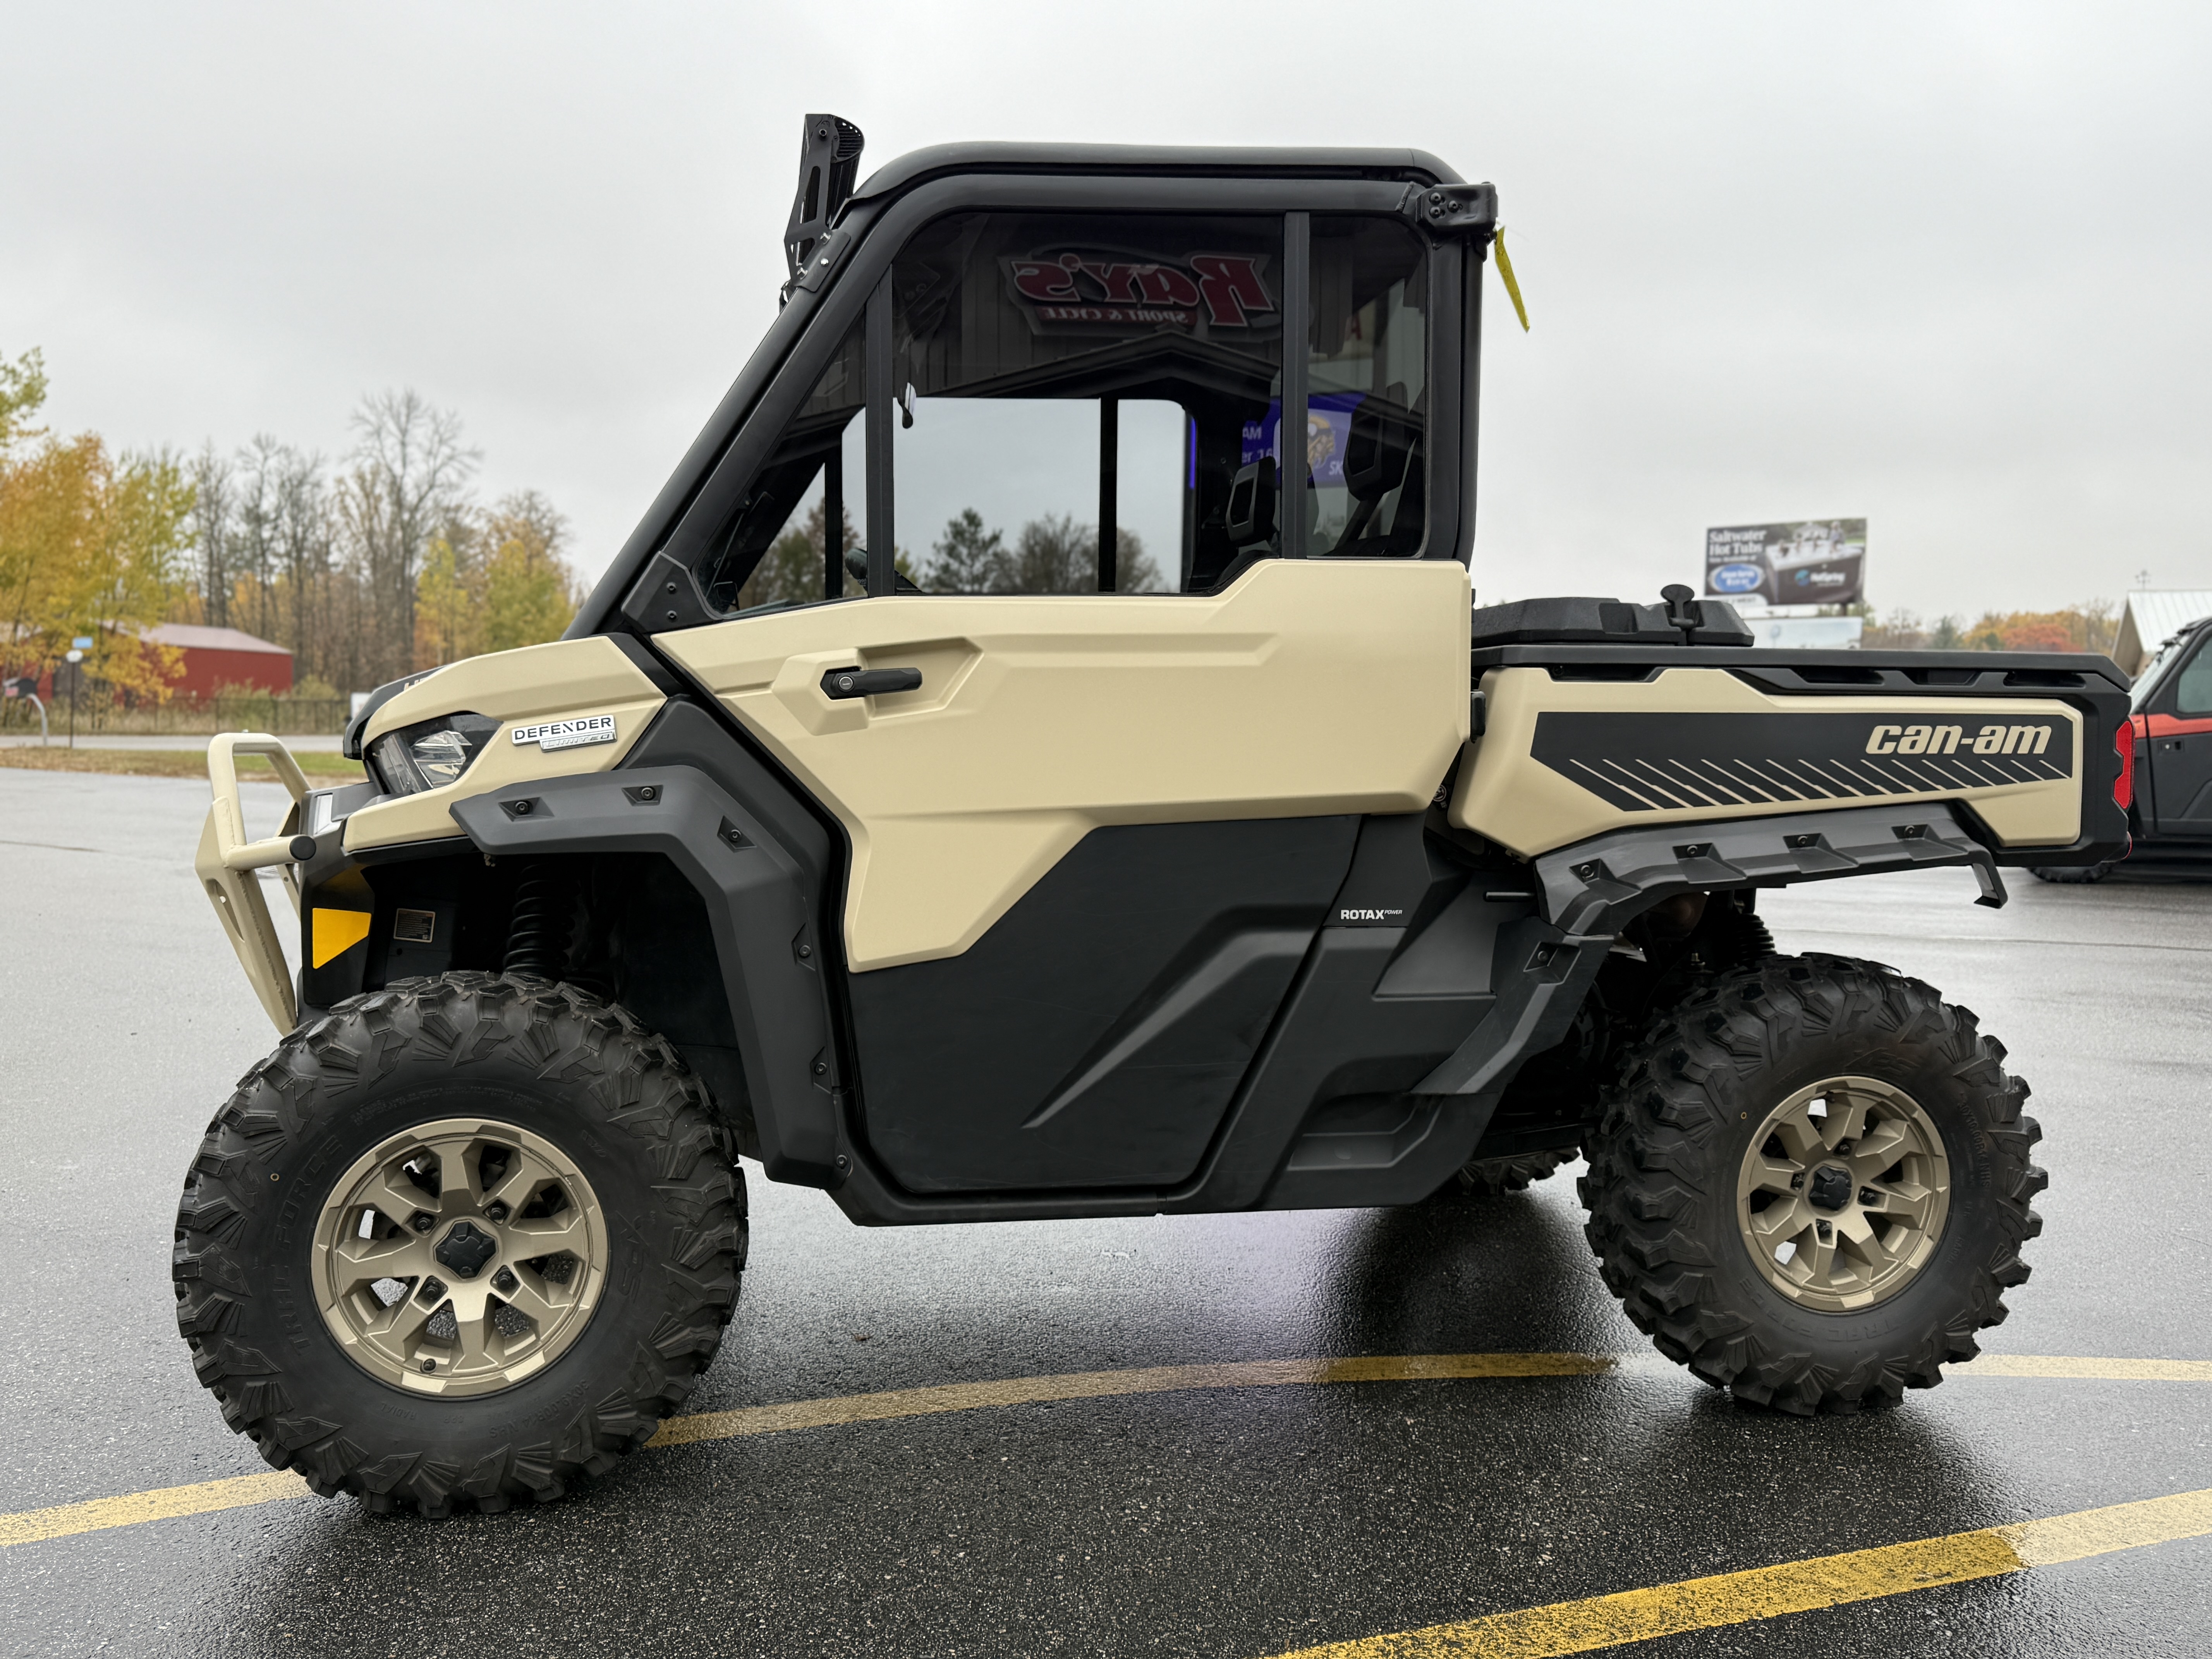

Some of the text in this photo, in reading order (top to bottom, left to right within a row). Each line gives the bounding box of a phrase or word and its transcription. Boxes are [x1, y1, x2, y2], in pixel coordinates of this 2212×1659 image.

[1709, 530, 1767, 543] Saltwater
[1709, 541, 1763, 556] Hot Tubs
[515, 717, 612, 740] DEFENDER
[546, 733, 610, 747] LIMITED
[1865, 725, 2052, 755] can-am
[1341, 910, 1384, 920] ROTAX
[277, 1135, 343, 1249] FORCE
